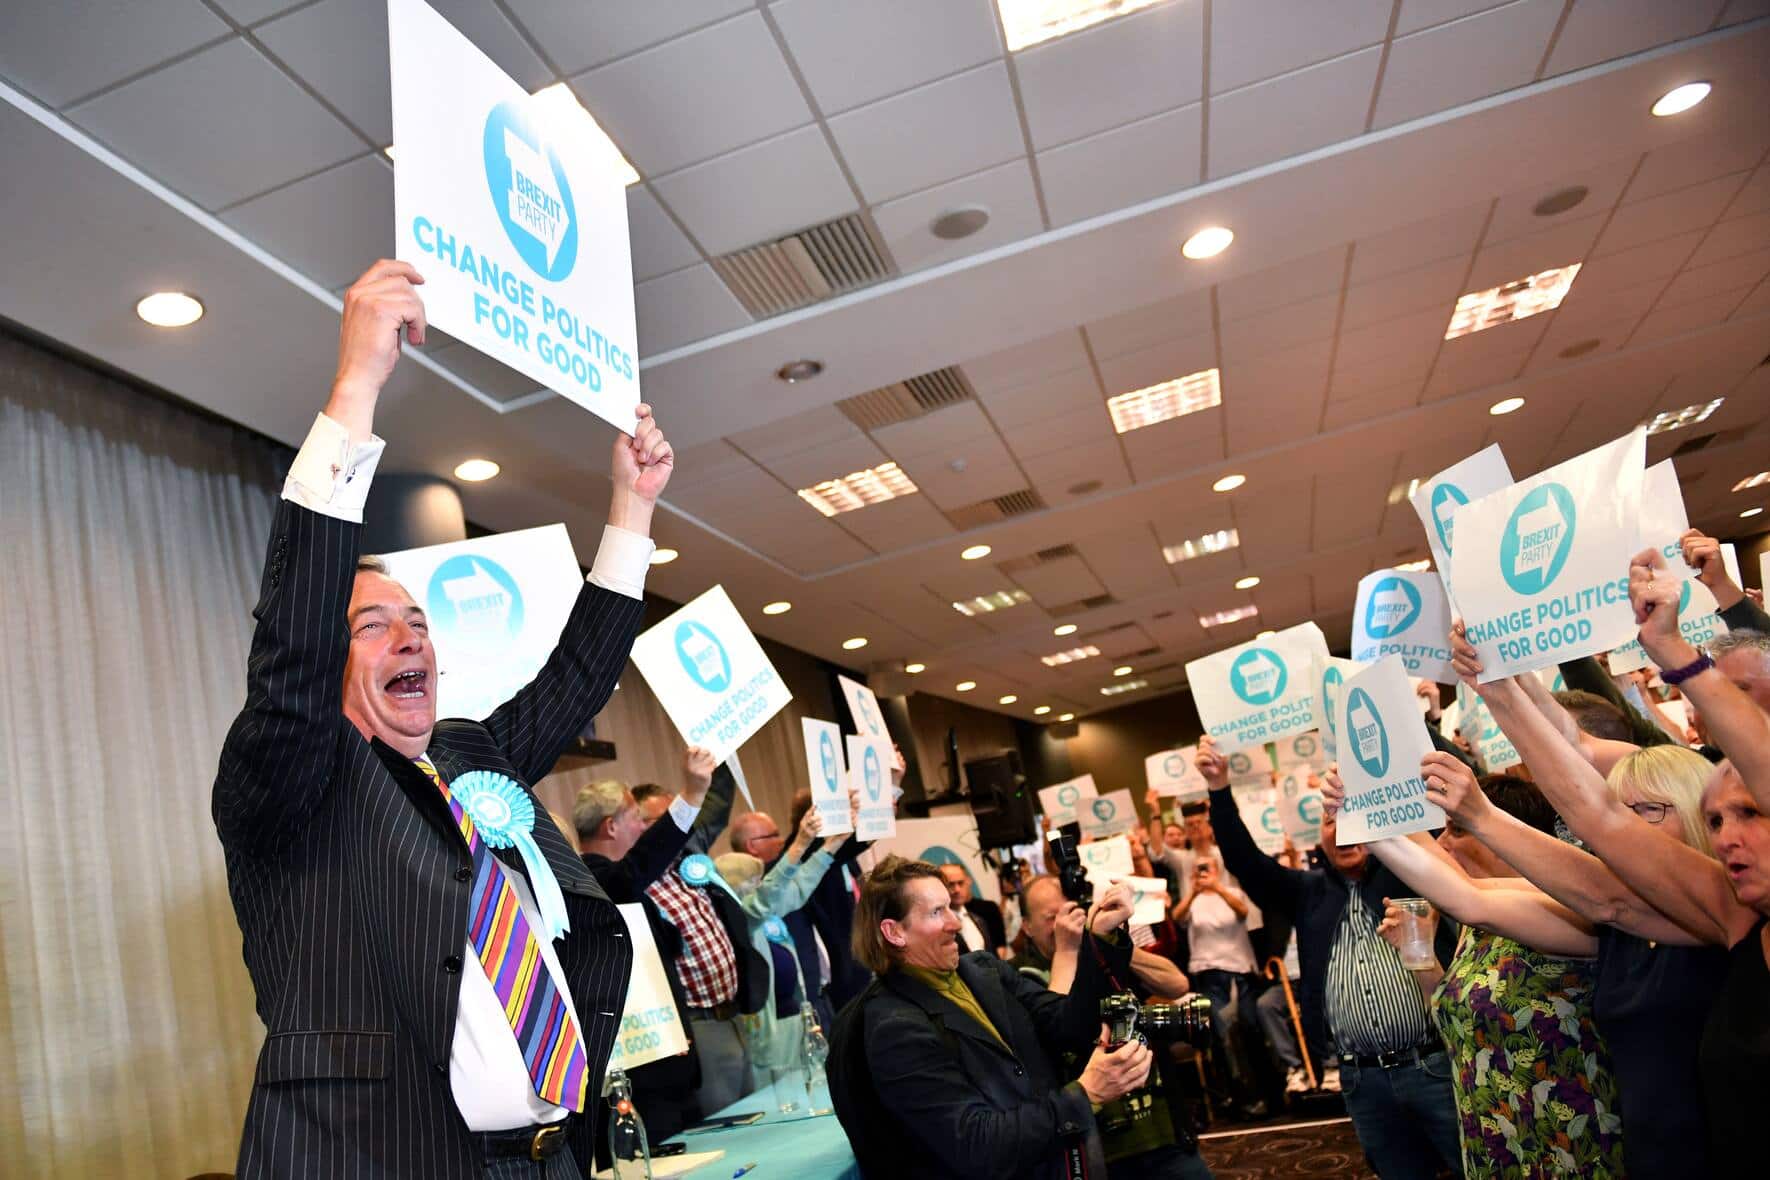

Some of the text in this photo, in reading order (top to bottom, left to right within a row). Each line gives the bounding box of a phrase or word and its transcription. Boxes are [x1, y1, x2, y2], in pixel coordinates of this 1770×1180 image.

[516, 169, 561, 223] BREXIT
[517, 194, 556, 241] PARTY
[413, 216, 633, 381] CHANGE POLITICS
[474, 291, 602, 393] FOR GOOD
[1520, 542, 1553, 568] PARTY
[1521, 522, 1561, 550] BREXIT
[1466, 577, 1629, 646] CHANGE POLITICS
[1497, 619, 1592, 663] FOR GOOD
[689, 700, 735, 743] CHANGE
[717, 696, 769, 745] FOR GOOD
[1210, 695, 1314, 737] CHANGE POLIT
[1238, 712, 1313, 743] FOR GOOD
[1343, 777, 1426, 813] CHANGE POLITI
[1366, 801, 1425, 830] FOR GOOD
[622, 1006, 675, 1031] POLITICS
[625, 1031, 661, 1056] GOOD
